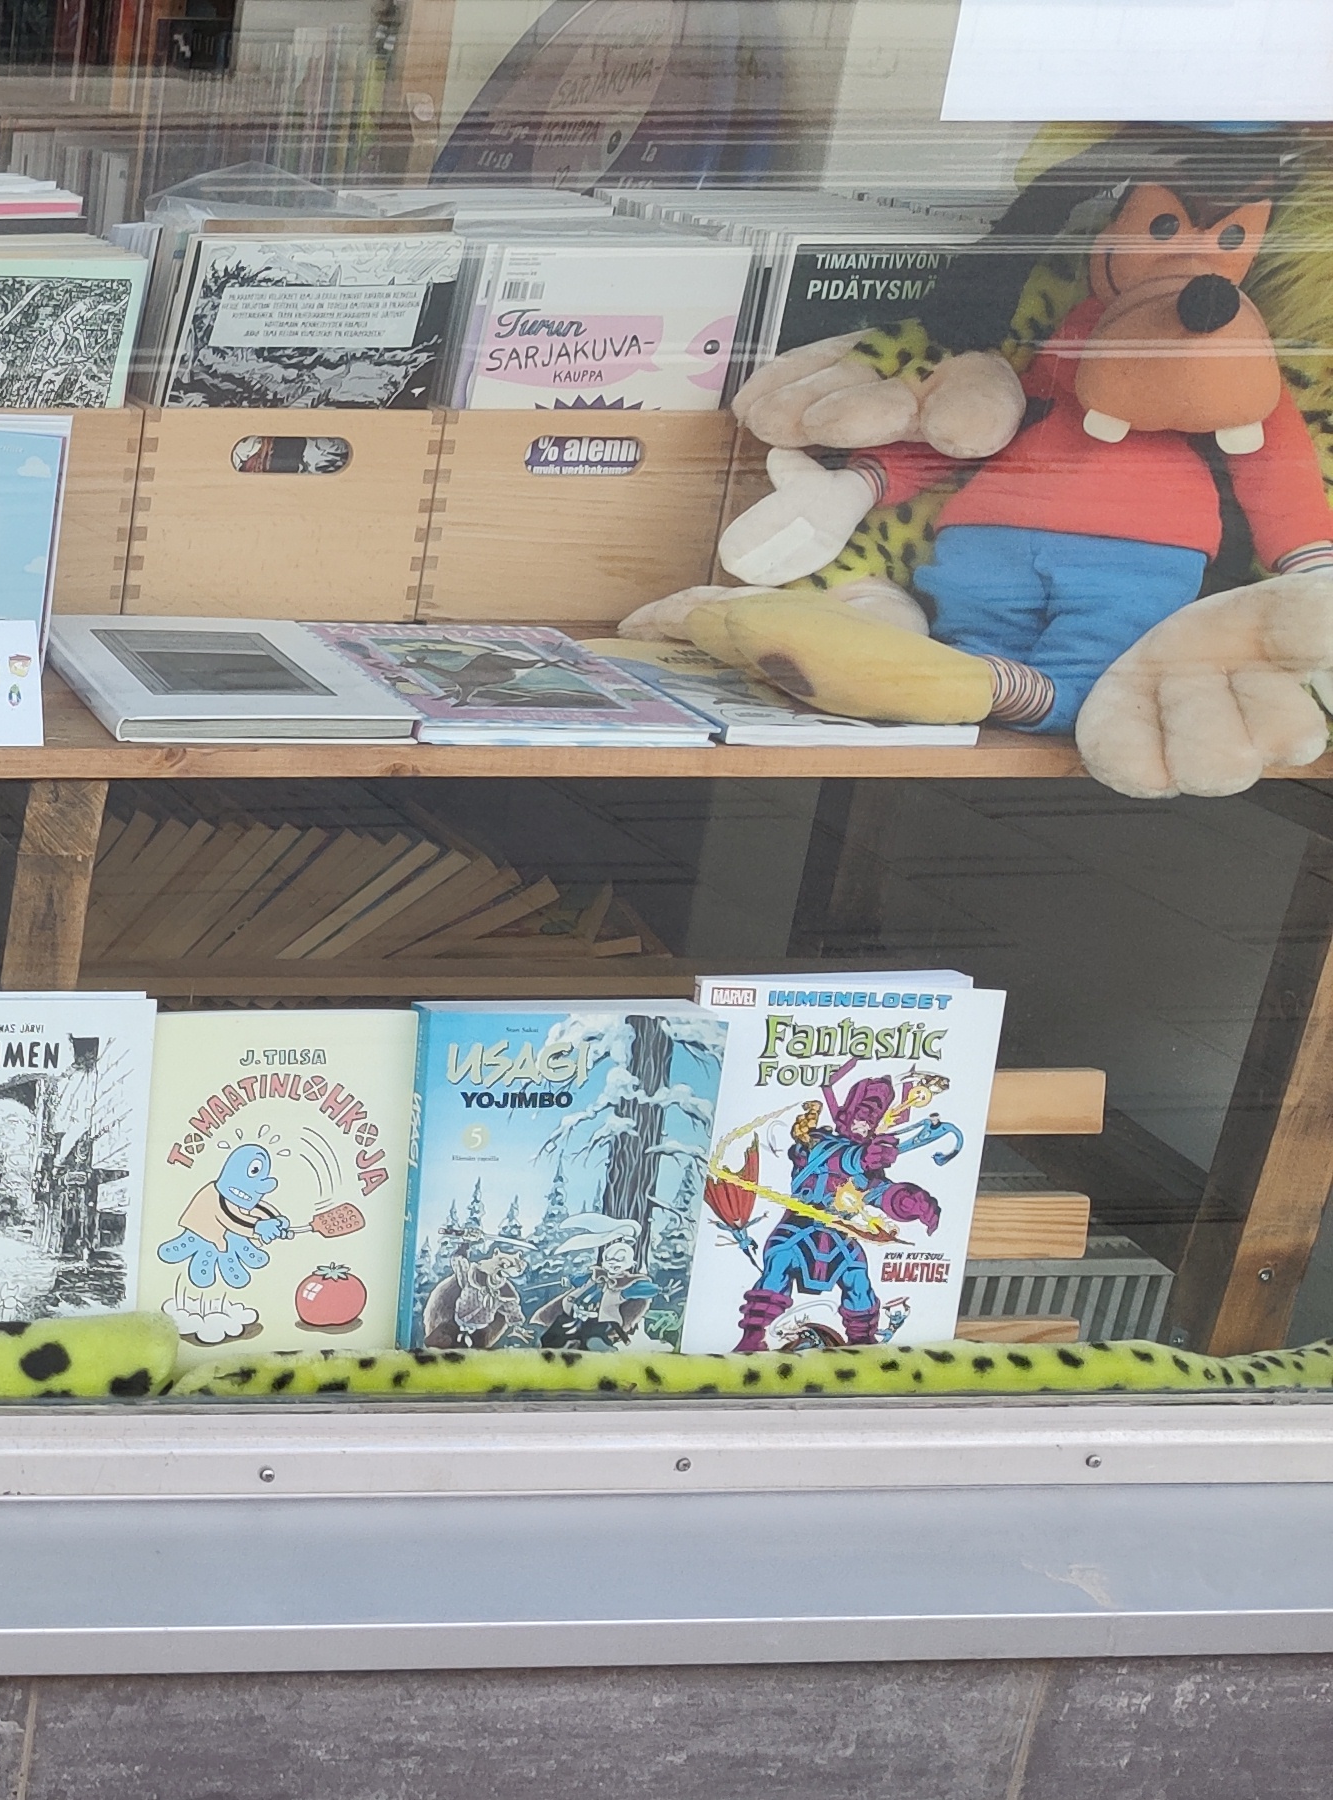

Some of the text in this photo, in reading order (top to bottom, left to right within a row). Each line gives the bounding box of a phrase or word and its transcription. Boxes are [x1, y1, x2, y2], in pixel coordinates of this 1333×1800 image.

[807, 275, 937, 300] PIDÄTYSMÄ
[495, 308, 587, 339] Turun
[486, 334, 655, 371] SARJAKUVA-
[552, 370, 603, 383] KAUPPA
[563, 437, 641, 462] alenn
[712, 988, 953, 1009] MARVEL IHMENELOSET
[757, 1014, 949, 1061] Fantastic
[445, 1039, 590, 1089] USAGI
[460, 1091, 574, 1109] YOJIMBO
[167, 1073, 389, 1197] TOMAATINLOHKOJA
[470, 1127, 482, 1149] 5
[881, 1262, 950, 1283] GALACTUS!
